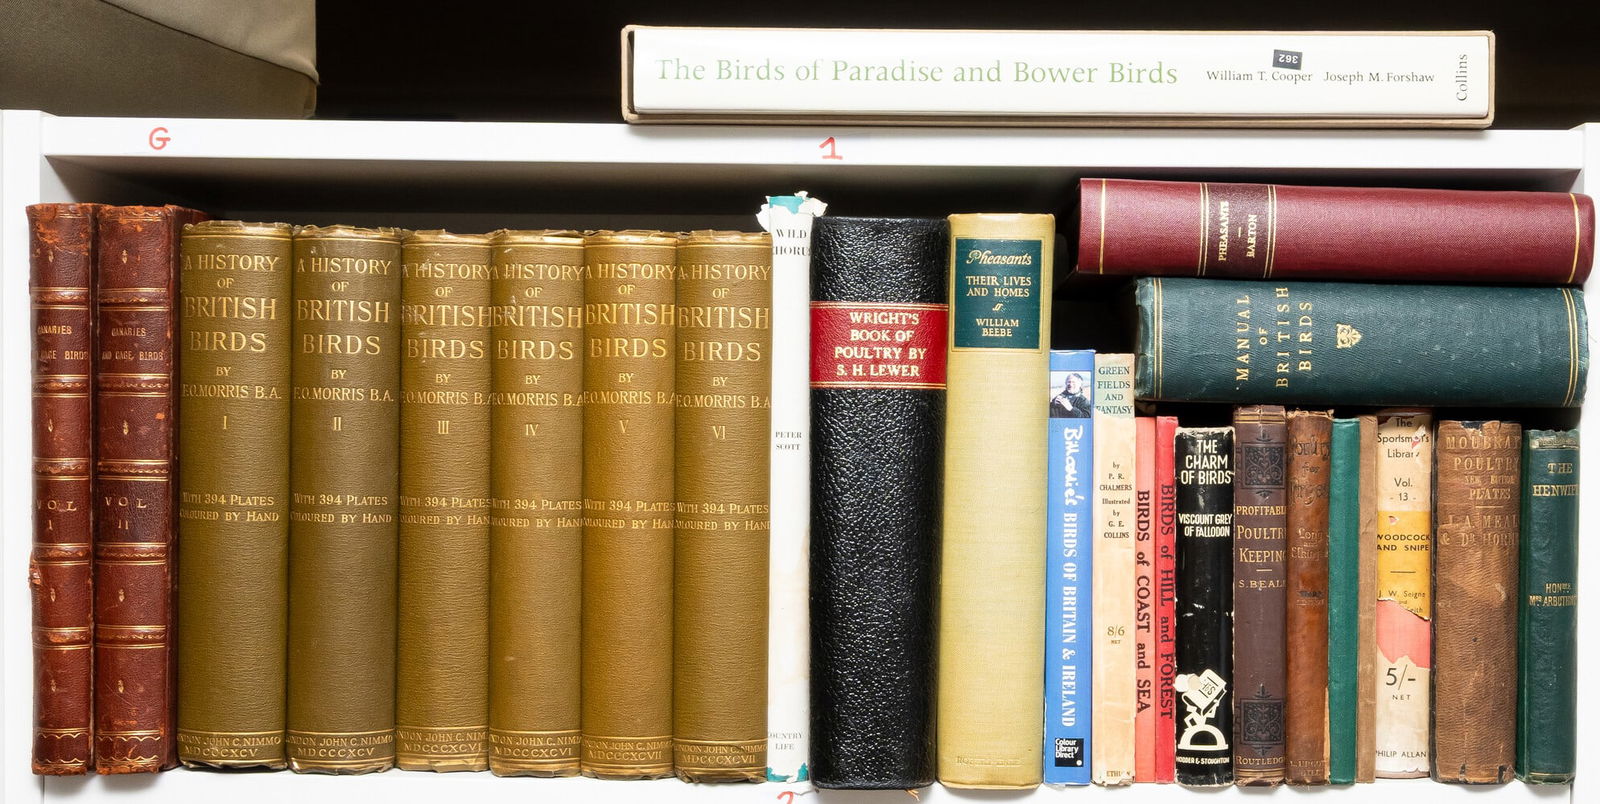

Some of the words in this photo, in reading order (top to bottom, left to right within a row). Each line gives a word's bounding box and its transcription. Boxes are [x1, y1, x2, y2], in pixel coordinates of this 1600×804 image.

[1278, 53, 1298, 64] 362
[655, 59, 706, 81] The
[716, 58, 784, 81] Birds
[796, 59, 824, 81] of
[832, 59, 942, 83] Paradise
[953, 59, 1001, 82] and
[1014, 61, 1098, 83] Bower
[1109, 61, 1178, 84] Birds
[1207, 71, 1253, 81] William
[1258, 71, 1268, 81] T.
[1272, 71, 1313, 85] Cooper
[1323, 71, 1364, 85] Joseph
[1369, 72, 1383, 82] M.
[1387, 71, 1435, 82] Forshaw
[1456, 54, 1468, 101] Collins
[149, 127, 171, 150] G
[819, 136, 843, 160] 1
[1218, 201, 1230, 261] PHEASANTS
[1246, 214, 1258, 258] BARTON
[199, 254, 279, 272] HISTORY
[966, 249, 1032, 265] Pheasants
[311, 257, 392, 275] HISTORY
[415, 263, 491, 280] HISTORY
[505, 264, 584, 281] HISTORY
[598, 263, 676, 280] HISTORY
[692, 264, 771, 281] HISTORY
[217, 278, 234, 289] OF
[331, 281, 349, 292] OF
[966, 276, 1000, 286] THEIR
[1003, 276, 1032, 286] LIVES
[435, 287, 453, 297] OF
[525, 287, 543, 297] OF
[618, 284, 635, 295] OF
[712, 288, 730, 298] OF
[966, 287, 989, 297] AND
[994, 288, 1030, 297] HOMES
[184, 297, 276, 320] BRITISH
[297, 299, 390, 323] BRITISH
[402, 305, 491, 327] BRITISH
[586, 303, 675, 325] BRITISH
[493, 305, 582, 328] BRITISH
[679, 307, 769, 329] BRITISH
[850, 312, 920, 324] WRIGHT'S
[976, 318, 1019, 327] WILLIAM
[850, 329, 892, 342] BOOK
[895, 330, 915, 342] OF
[981, 328, 1013, 337] BEEBE
[1236, 295, 1250, 381] MANUAL
[1259, 327, 1268, 345] OF
[1276, 287, 1290, 388] BRITISH
[1299, 302, 1313, 371] BIRDS
[190, 331, 266, 352] BIRDS
[303, 334, 381, 355] BIRDS
[407, 338, 484, 359] BIRDS
[591, 338, 666, 358] BIRDS
[138, 351, 164, 361] BIRDS
[498, 340, 573, 360] BIRDS
[684, 342, 761, 361] BIRDS
[834, 347, 903, 359] POULTRY
[908, 347, 927, 360] BY
[216, 366, 231, 376] BY
[836, 365, 847, 376] S.
[852, 365, 866, 376] H.
[869, 365, 920, 377] LEWER
[1098, 366, 1130, 375] GREEN
[712, 377, 728, 387] BY
[1097, 380, 1131, 389] FIELDS
[1105, 393, 1124, 401] AND
[333, 416, 342, 431] II
[438, 421, 449, 434] III
[525, 424, 538, 436] IV
[619, 420, 629, 433] V
[1396, 418, 1413, 428] The
[712, 426, 726, 440] VI
[776, 431, 802, 439] PETER
[1196, 439, 1218, 454] THE
[1112, 461, 1120, 469] by
[1185, 454, 1228, 470] CHARM
[1547, 462, 1573, 474] THE
[1180, 470, 1195, 485] OF
[1198, 470, 1232, 485] BIRDS
[1394, 477, 1413, 487] Vol.
[1399, 492, 1409, 501] 13
[1112, 509, 1120, 517] by
[1137, 490, 1150, 542] BIRDS
[1161, 483, 1174, 536] BIRDS
[1236, 505, 1287, 516] PROFITABL
[1178, 513, 1215, 525] VISCOUNT
[1214, 513, 1232, 525] GREY
[1063, 513, 1077, 558] BIRDS
[1184, 526, 1195, 537] OF
[1195, 526, 1230, 538] FALLODON
[1237, 525, 1287, 540] POULTR
[1160, 545, 1173, 560] of
[1377, 544, 1397, 552] AND
[1404, 544, 1429, 552] SNIPE
[1137, 551, 1150, 567] of
[1063, 562, 1077, 581] OF
[1161, 569, 1174, 607] HILL
[1136, 575, 1151, 633] COAST
[1062, 586, 1077, 643] BRITAIN
[1107, 625, 1125, 637] 8/6
[1160, 616, 1173, 643] and
[1062, 648, 1076, 660] &
[1137, 642, 1151, 670] and
[1386, 664, 1416, 691] 5/-
[1160, 652, 1174, 719] FOREST
[1061, 665, 1076, 727] IRELAND
[1137, 679, 1151, 714] SEA
[1055, 738, 1077, 746] Colour
[1055, 744, 1079, 754] Library
[1200, 757, 1230, 765] STOUGHTON
